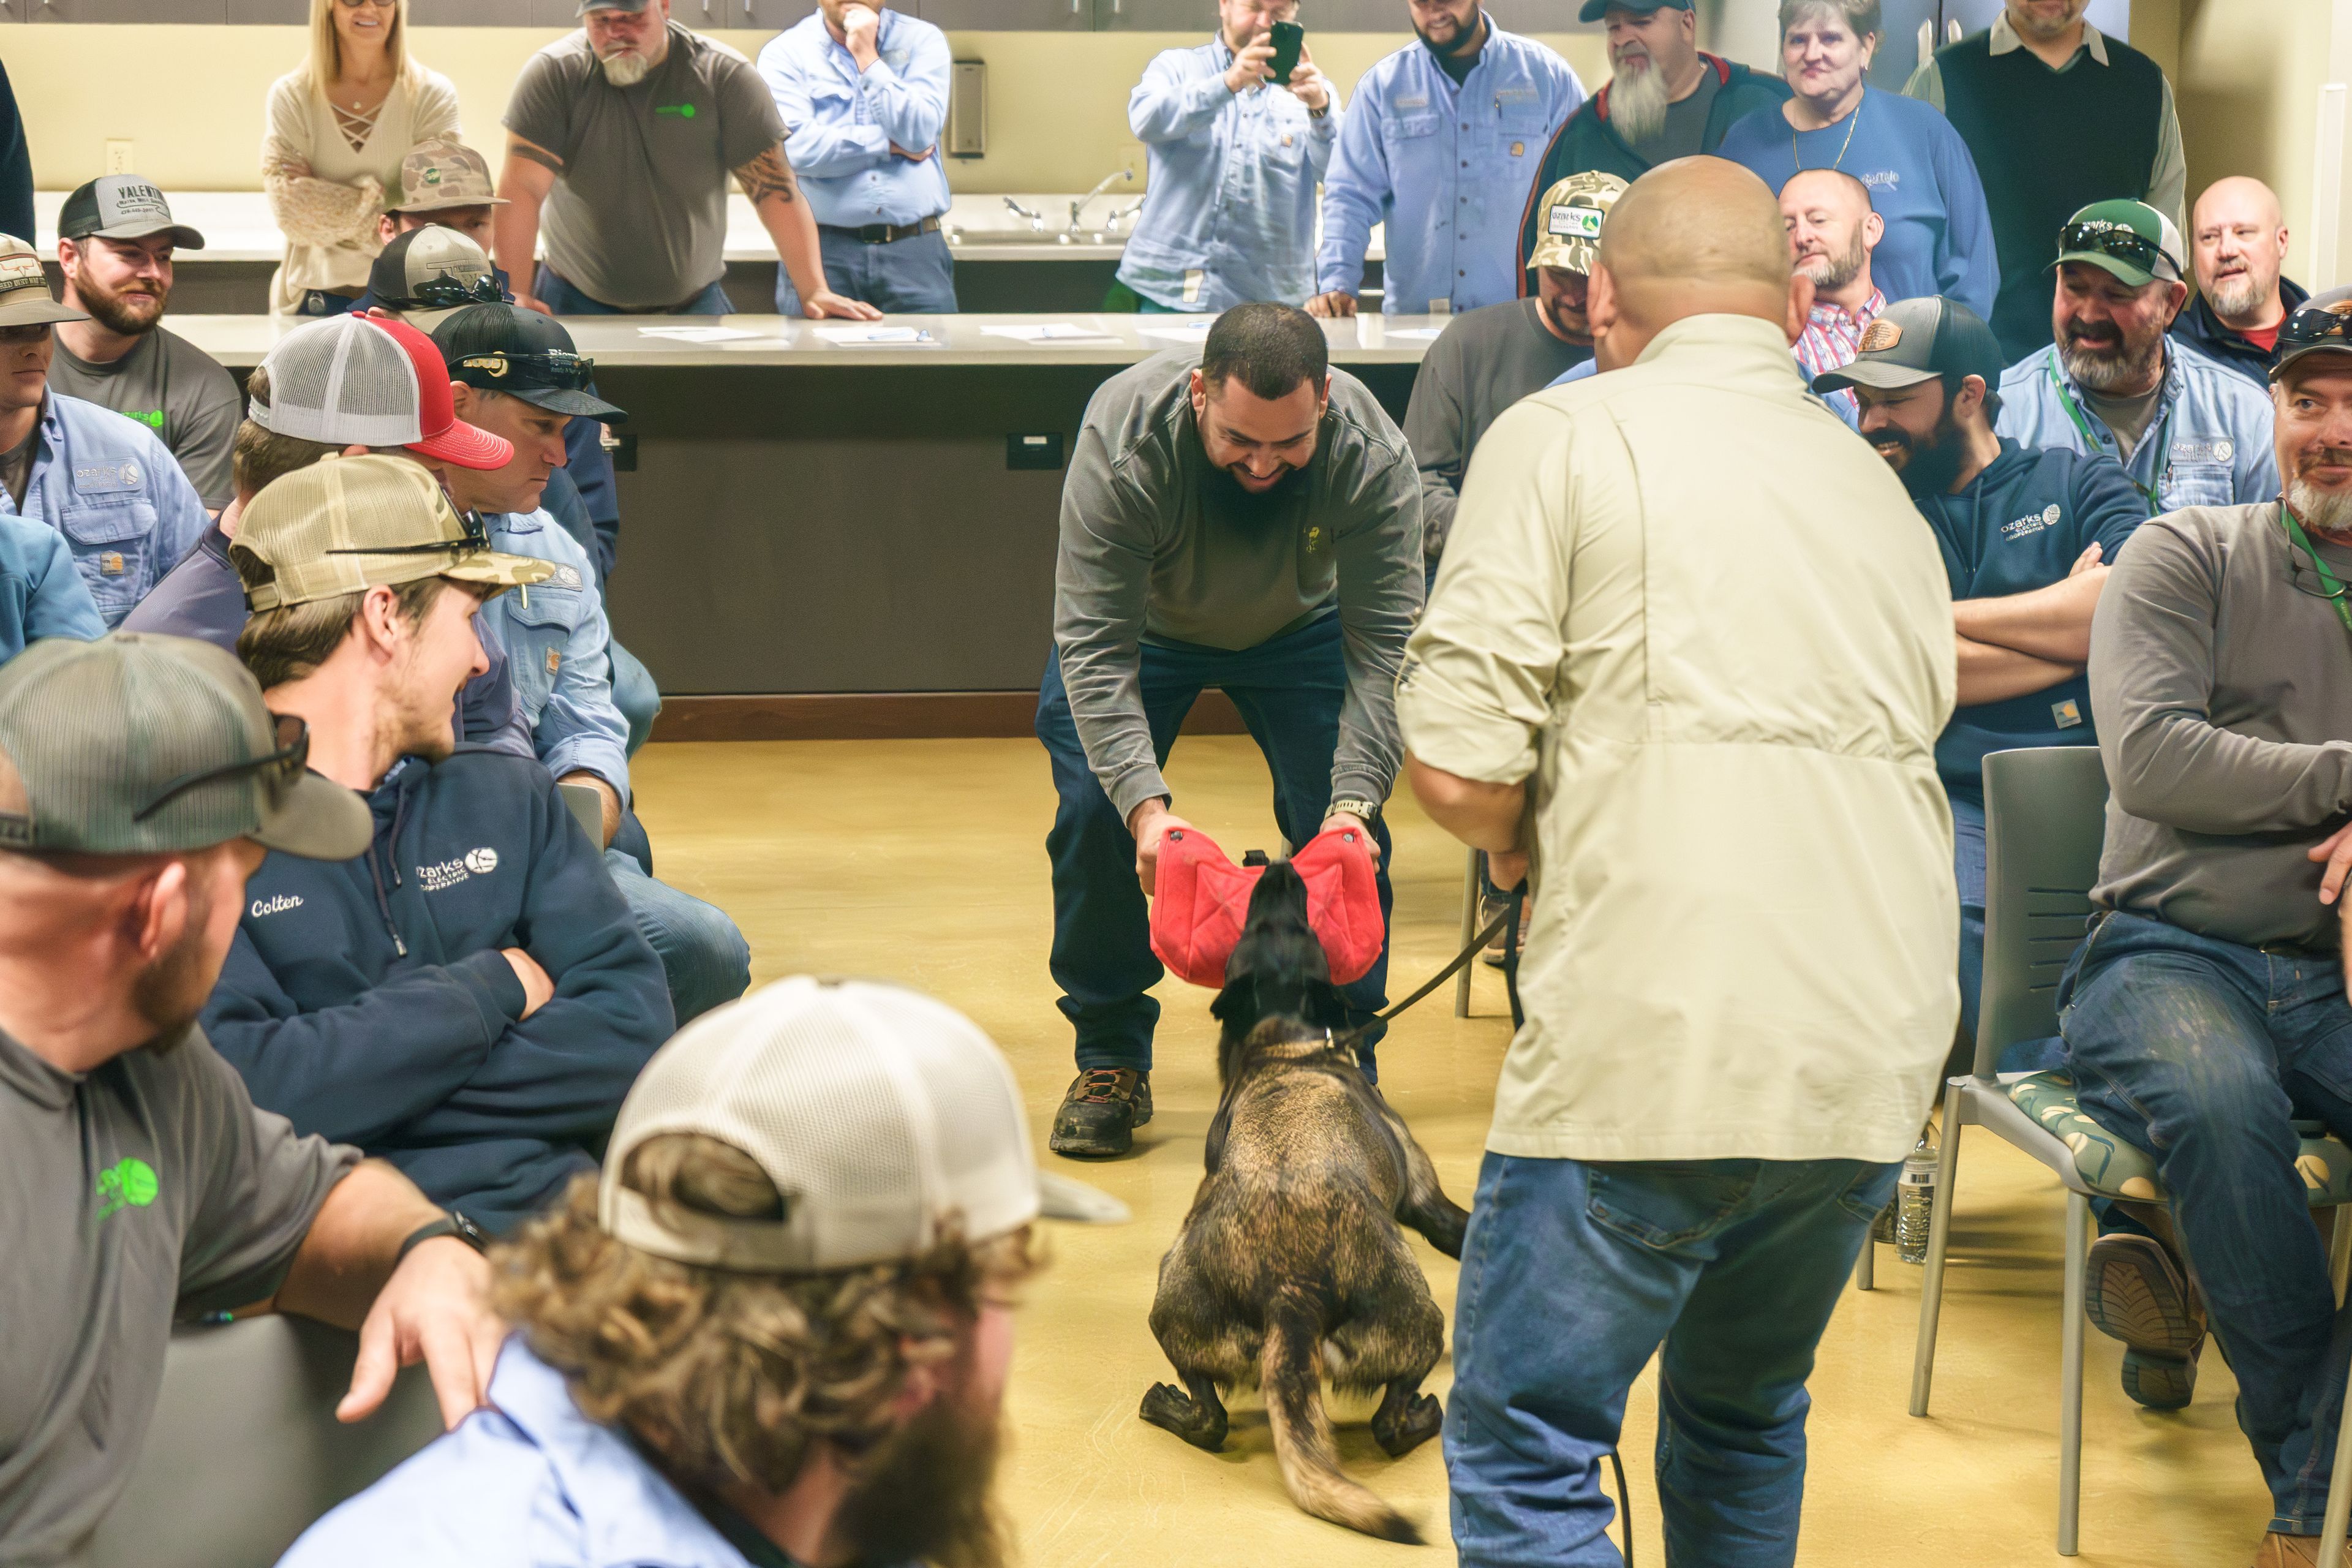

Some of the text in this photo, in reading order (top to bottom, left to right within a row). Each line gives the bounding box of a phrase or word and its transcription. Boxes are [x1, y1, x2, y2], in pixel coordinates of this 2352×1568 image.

[77, 466, 117, 478] ozarks
[2000, 513, 2041, 533] ozarks
[251, 894, 304, 918] Colten
